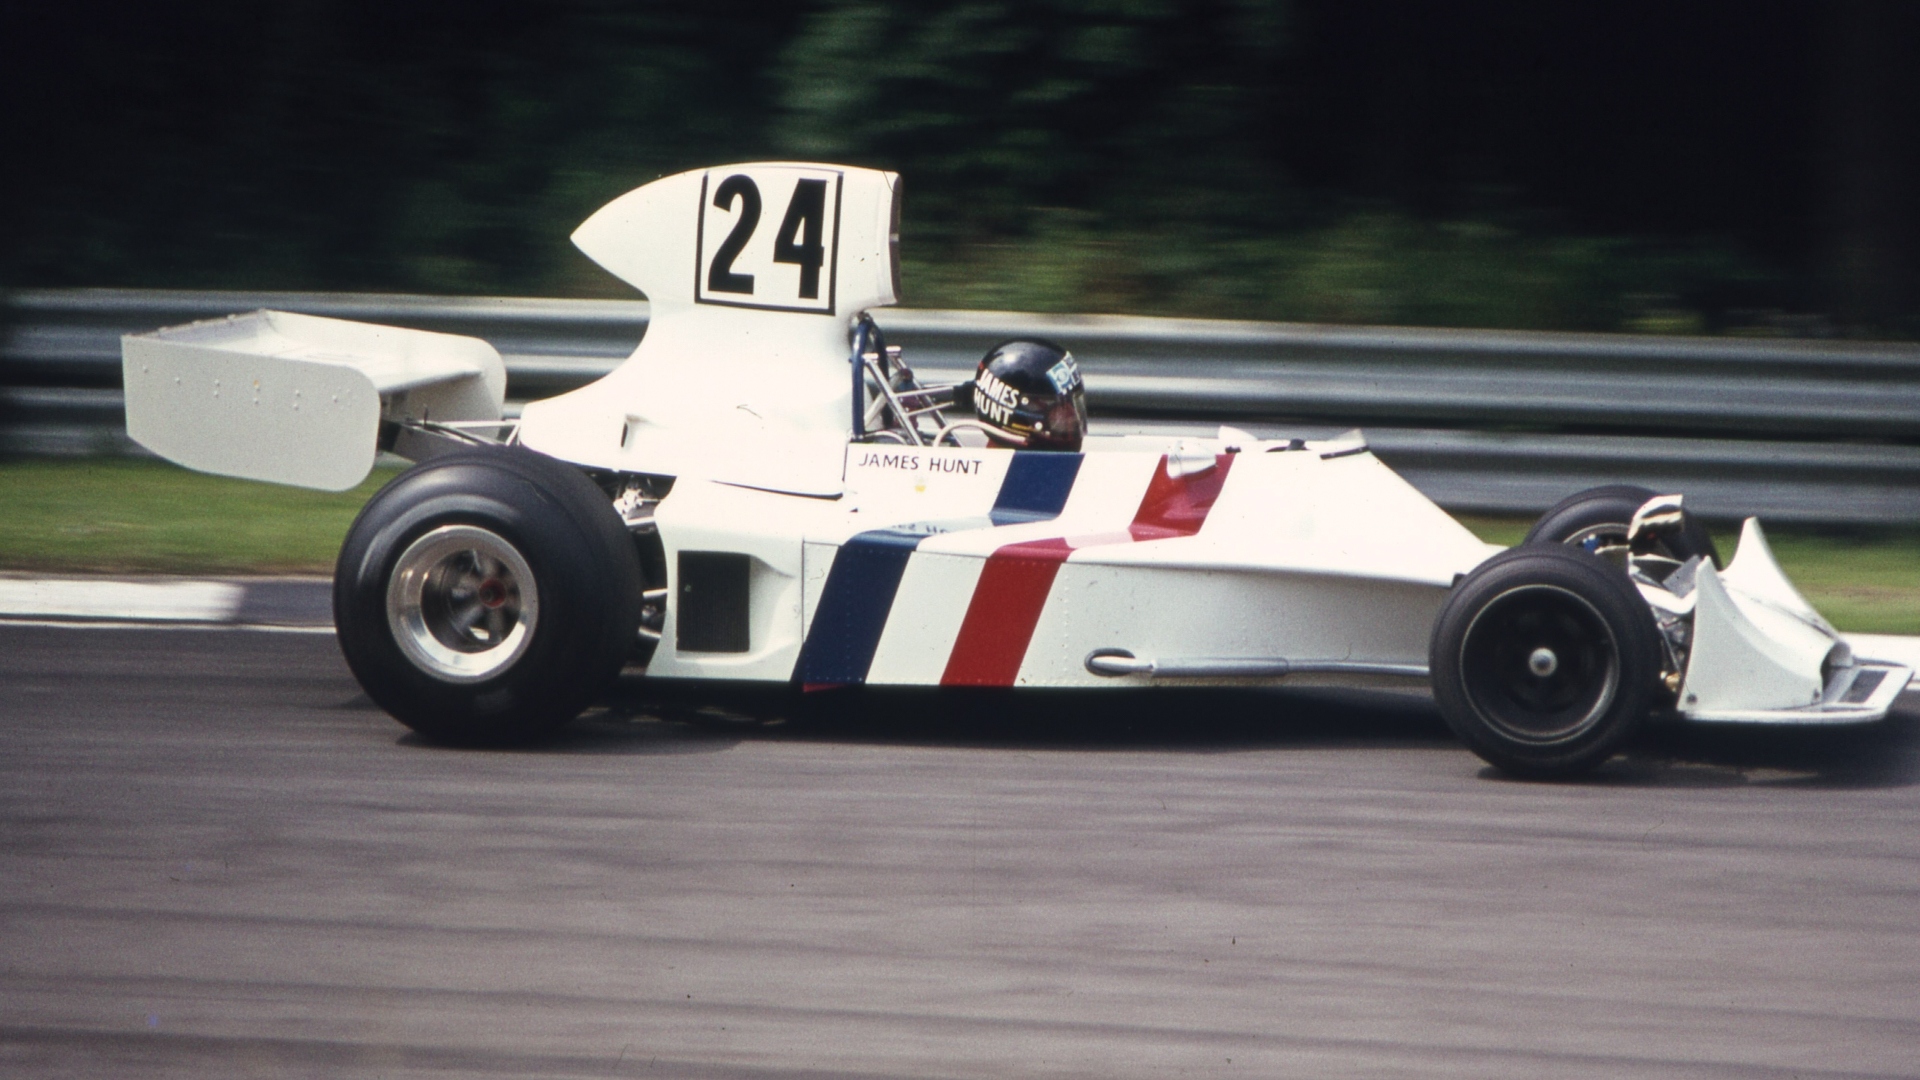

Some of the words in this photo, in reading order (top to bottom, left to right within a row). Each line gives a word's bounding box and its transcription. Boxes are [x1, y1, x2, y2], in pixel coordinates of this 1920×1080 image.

[708, 173, 826, 299] 24
[973, 387, 1014, 425] HUNT
[976, 368, 1020, 408] JAMES
[858, 453, 919, 470] JAMES
[929, 457, 982, 475] HUNT
